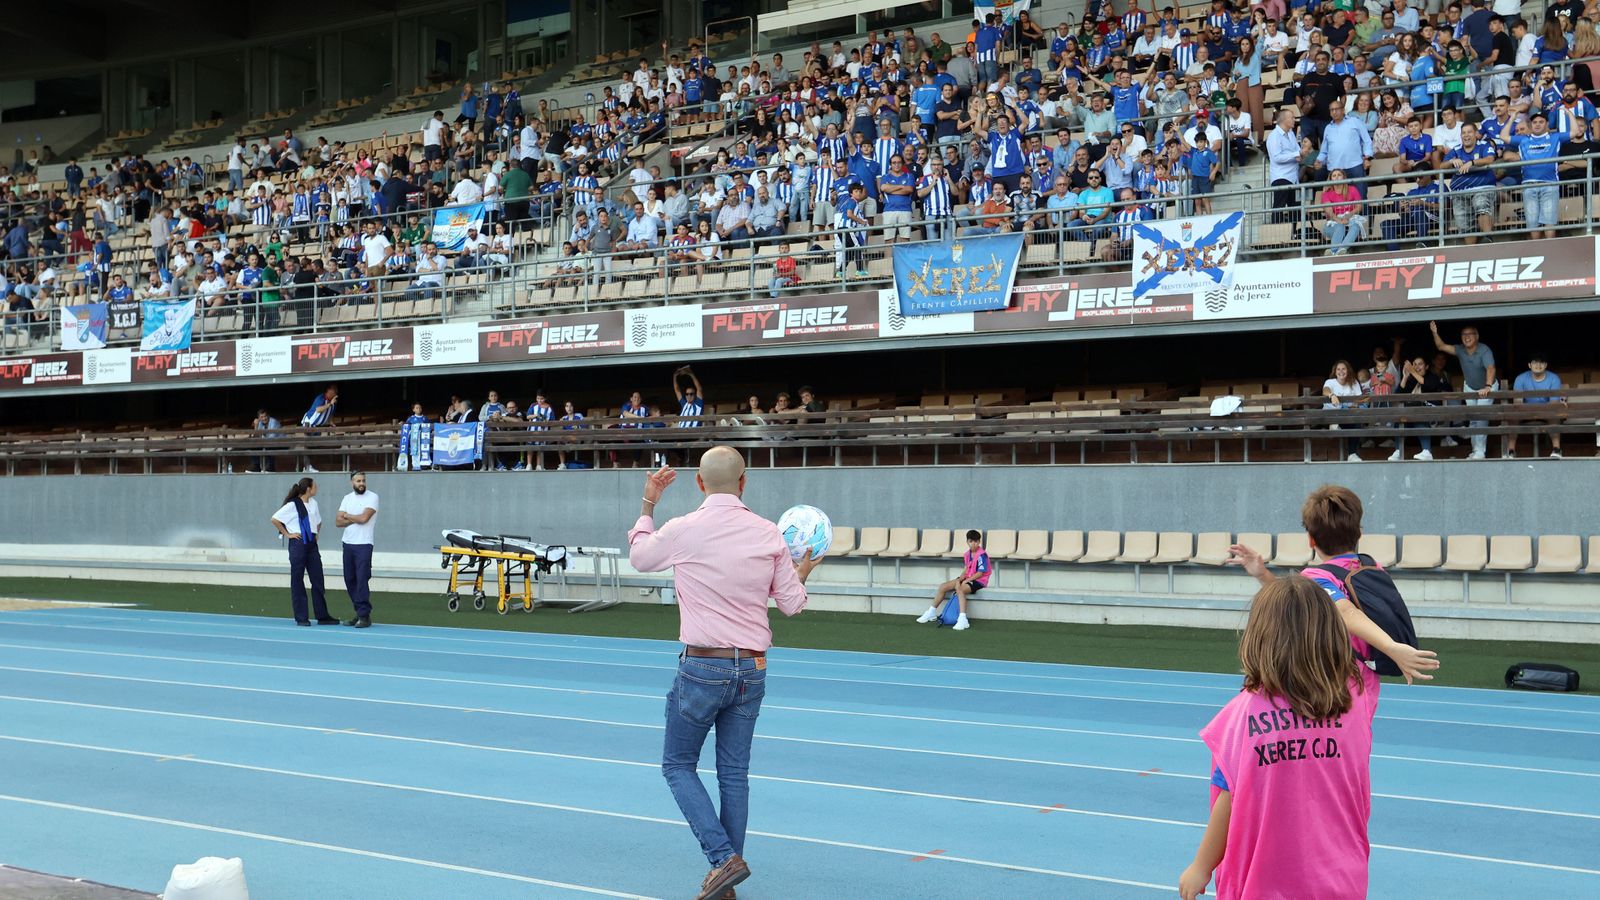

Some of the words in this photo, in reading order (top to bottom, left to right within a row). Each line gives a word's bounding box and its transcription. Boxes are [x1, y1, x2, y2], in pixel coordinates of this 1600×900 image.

[1141, 233, 1234, 276] XEREZ
[907, 254, 1004, 301] XEREZ
[1329, 265, 1424, 293] PLAY
[1013, 285, 1040, 293] NTRENA,
[1233, 280, 1301, 292] Ayuntamiento
[911, 302, 945, 310] FRENTE
[950, 297, 999, 307] CAPILLITA
[988, 291, 1062, 314] AY
[1233, 292, 1245, 301] de
[1247, 292, 1271, 302] Jerez
[651, 322, 695, 331] Ayuntamiento
[712, 311, 773, 332] PLAY
[487, 329, 537, 348] PLAY
[660, 330, 676, 338] Jerez
[435, 338, 473, 347] Ayuntamiento
[255, 351, 286, 359] Ayuntamiento
[298, 343, 340, 360] PLAY
[137, 355, 173, 370] PLAY
[1254, 739, 1308, 766] XEREZ
[1312, 738, 1341, 758] C.D.
